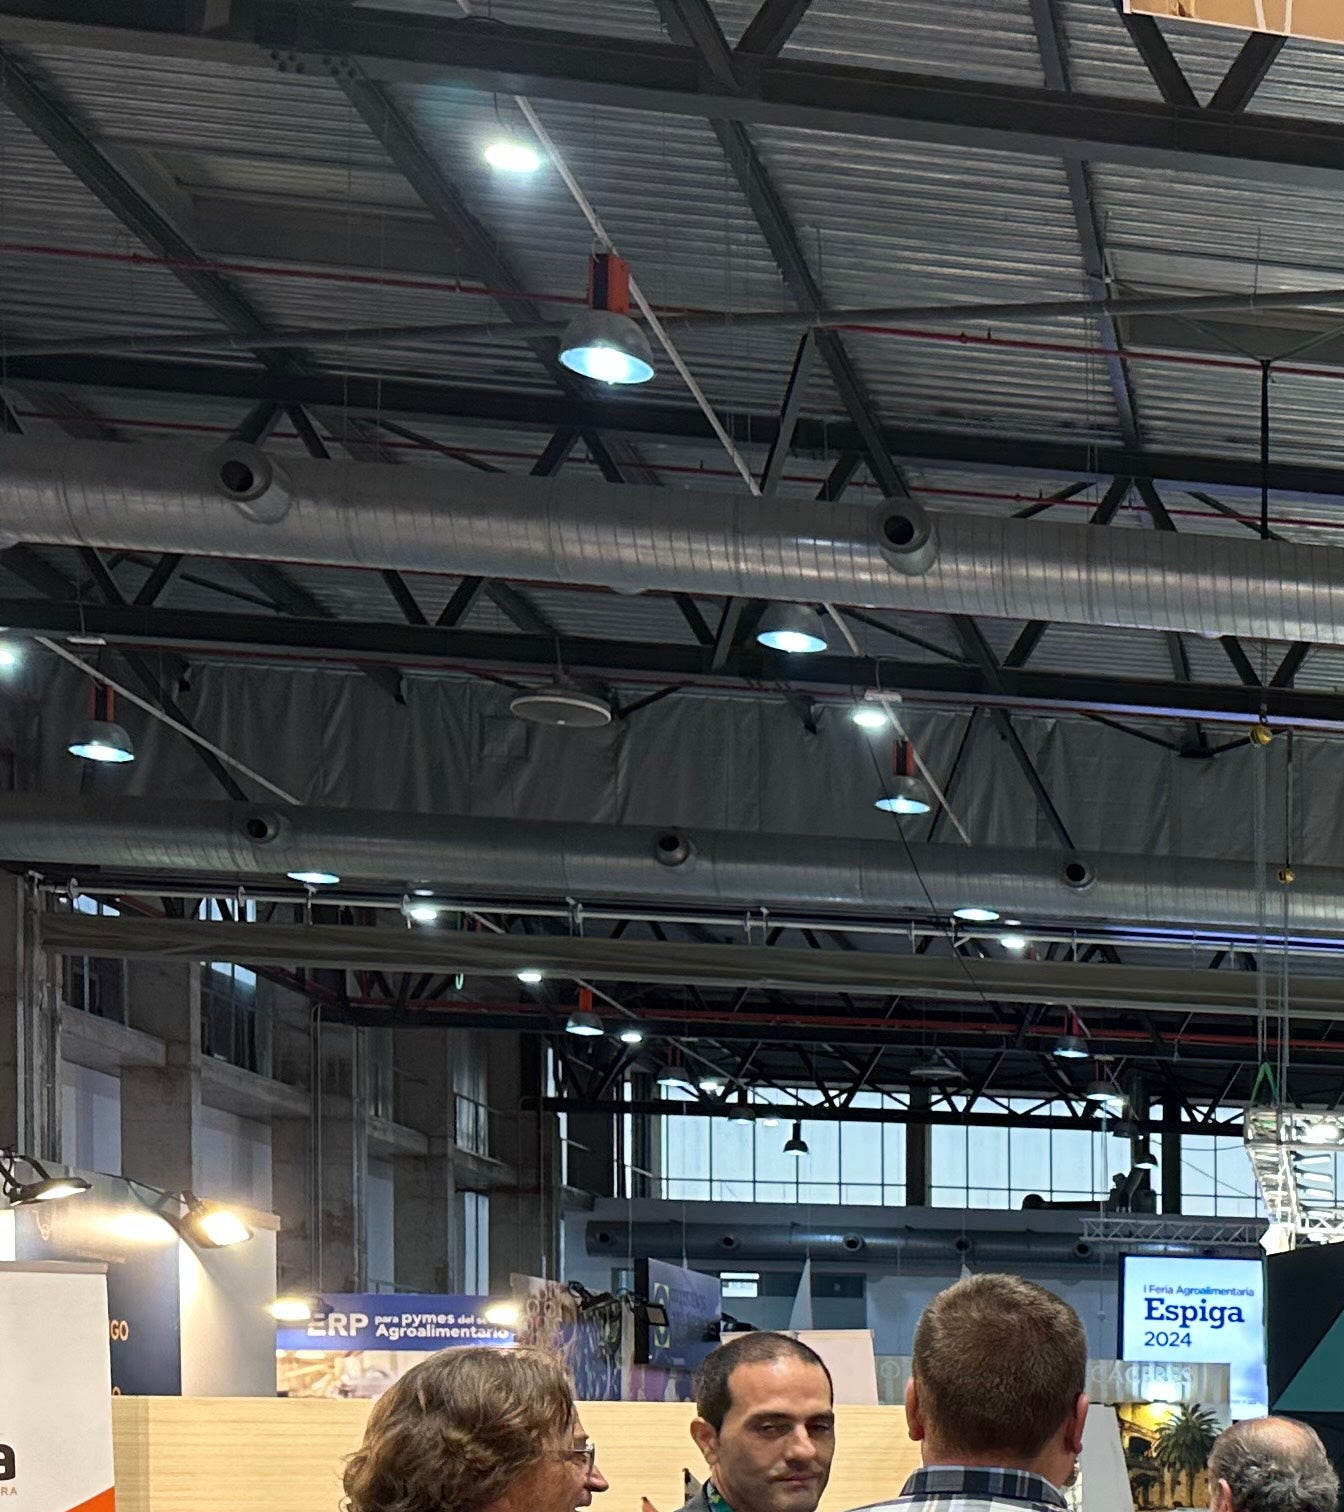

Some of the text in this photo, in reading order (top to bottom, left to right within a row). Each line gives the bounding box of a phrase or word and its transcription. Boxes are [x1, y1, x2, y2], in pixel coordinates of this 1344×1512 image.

[1149, 1284, 1174, 1295] Feria
[1176, 1285, 1255, 1297] Agroalimentaria
[1144, 1297, 1246, 1330] Espiga
[109, 1319, 130, 1342] GO
[307, 1313, 369, 1337] ERP
[375, 1316, 399, 1325] para
[401, 1313, 455, 1326] pymes
[458, 1316, 474, 1325] del
[375, 1322, 510, 1341] Agroalimentario
[1144, 1330, 1193, 1348] 2024
